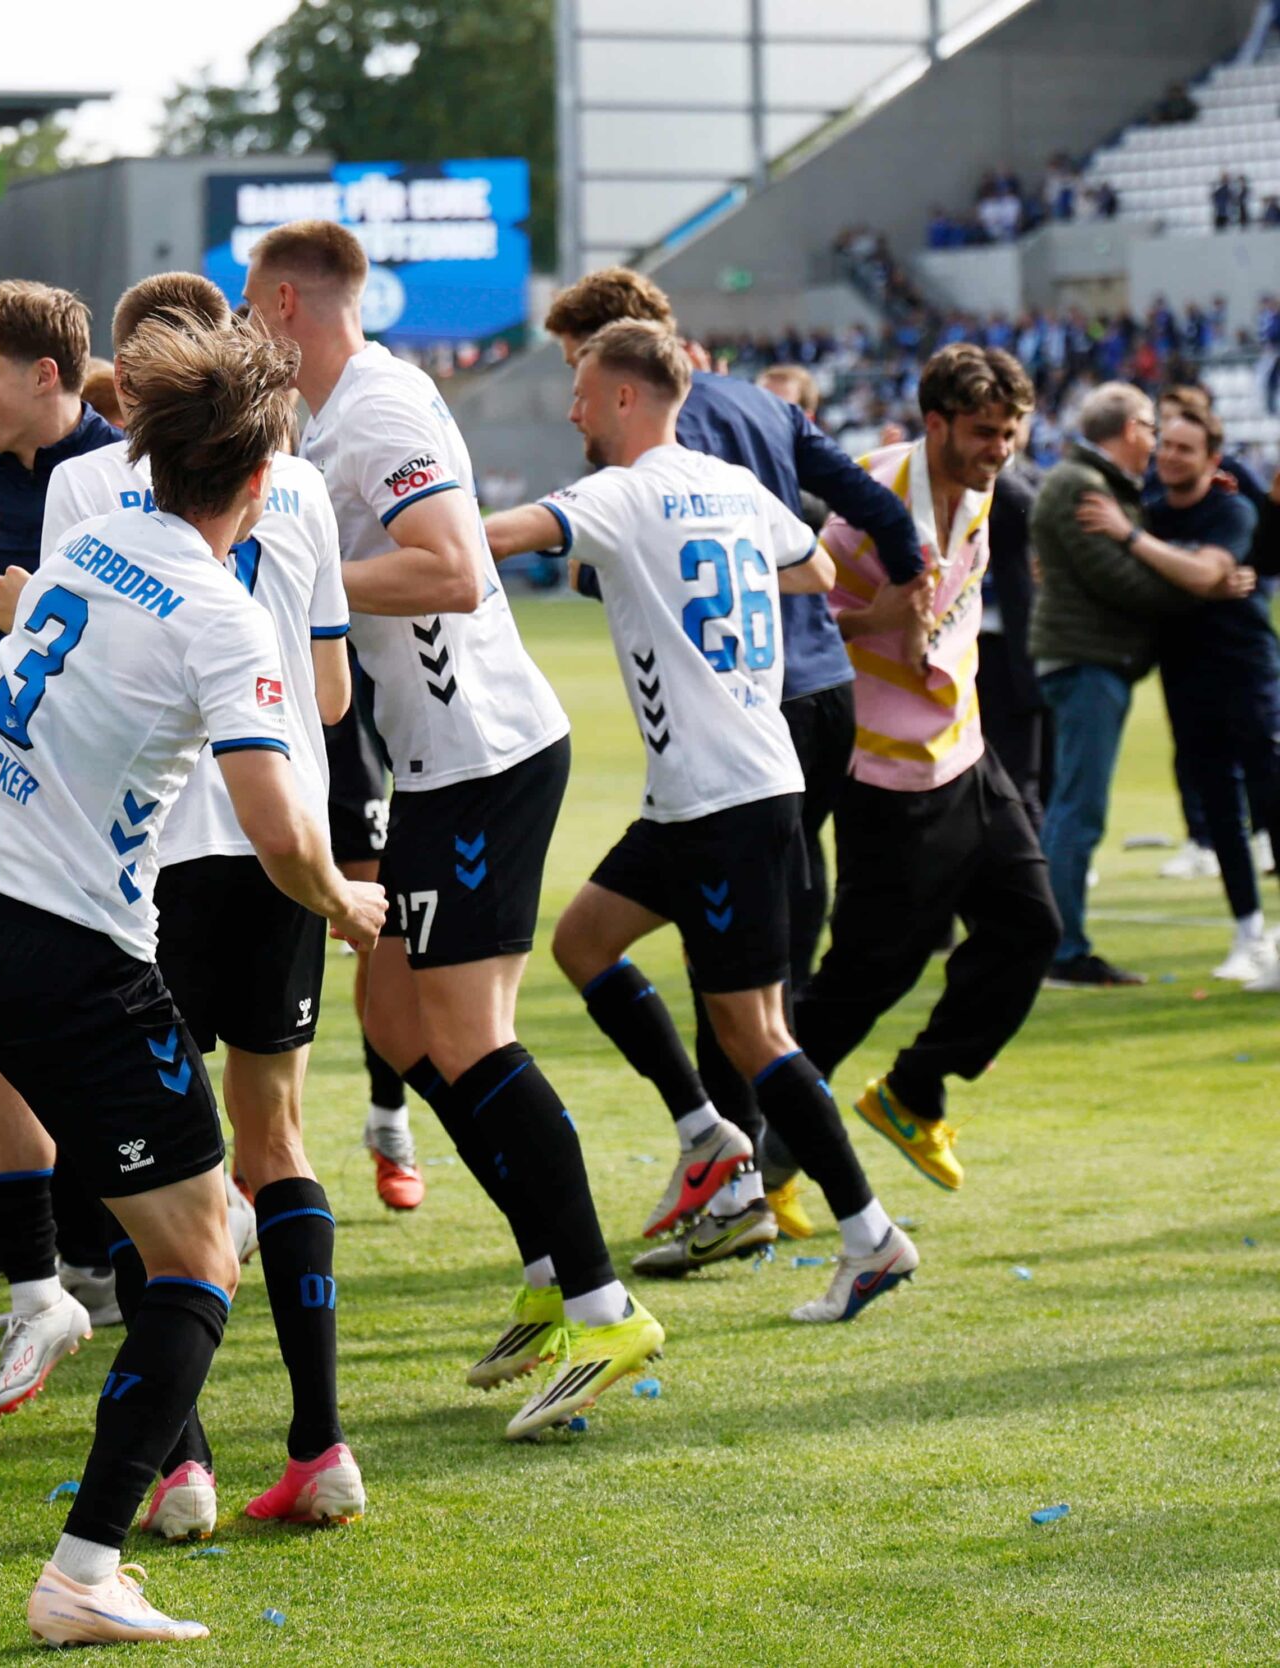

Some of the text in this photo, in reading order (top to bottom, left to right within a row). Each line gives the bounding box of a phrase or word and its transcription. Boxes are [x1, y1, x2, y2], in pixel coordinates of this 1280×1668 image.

[384, 453, 437, 487] MEDIA
[392, 464, 446, 497] COM
[679, 537, 775, 673] 26
[364, 798, 391, 850] 3
[120, 1155, 155, 1173] hummel
